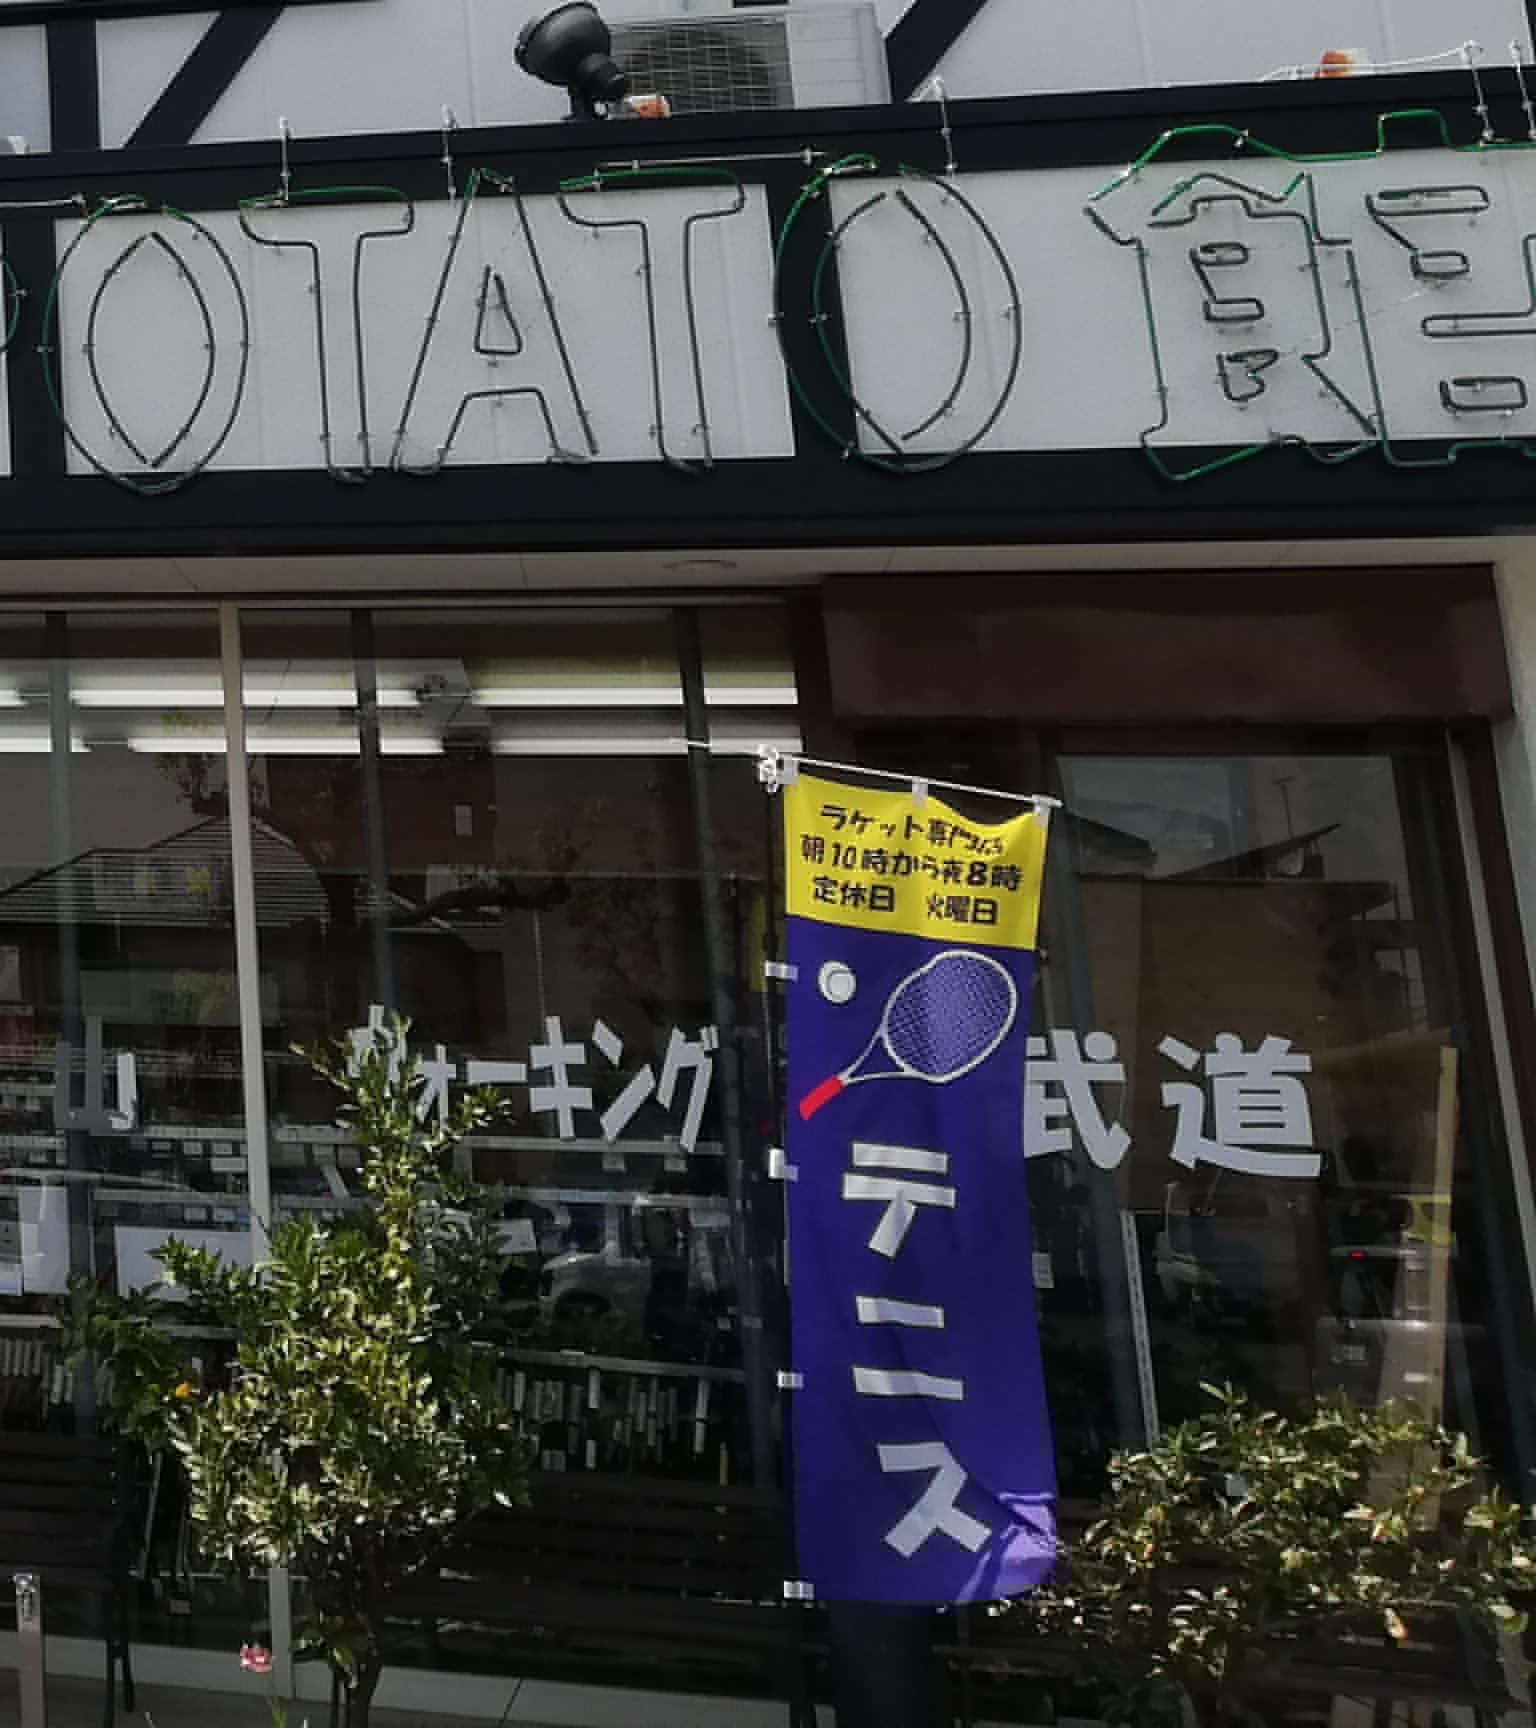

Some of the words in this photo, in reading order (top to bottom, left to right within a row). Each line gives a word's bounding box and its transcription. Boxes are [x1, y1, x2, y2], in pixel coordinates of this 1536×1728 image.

[799, 833, 1023, 892] 朝10時から夜8時
[813, 875, 896, 913] 定休日
[924, 894, 998, 926] 火曜日
[1024, 1028, 1322, 1179] 武道
[841, 1141, 993, 1559] テニス
